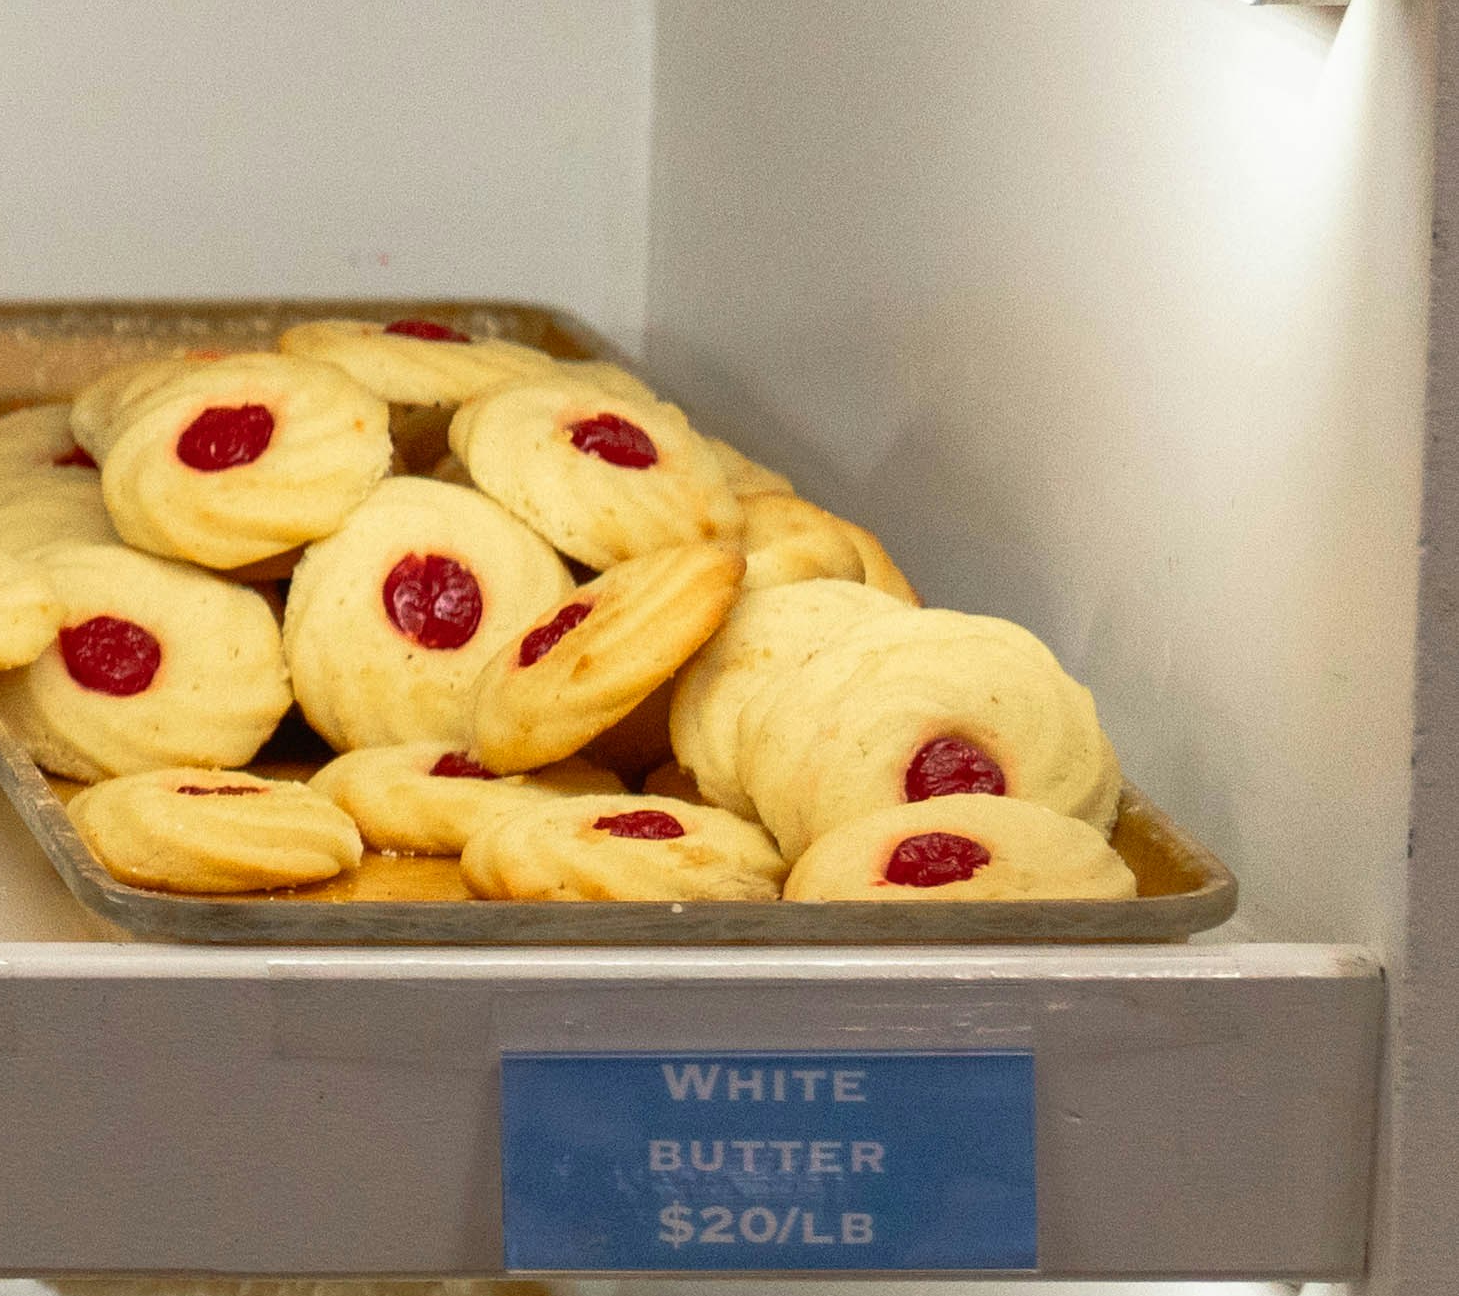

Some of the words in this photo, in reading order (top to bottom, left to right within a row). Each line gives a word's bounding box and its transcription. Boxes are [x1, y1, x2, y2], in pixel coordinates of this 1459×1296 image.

[662, 1064, 865, 1102] WHITE
[649, 1139, 886, 1174] BUTTER
[659, 1200, 874, 1249] $20/LB
